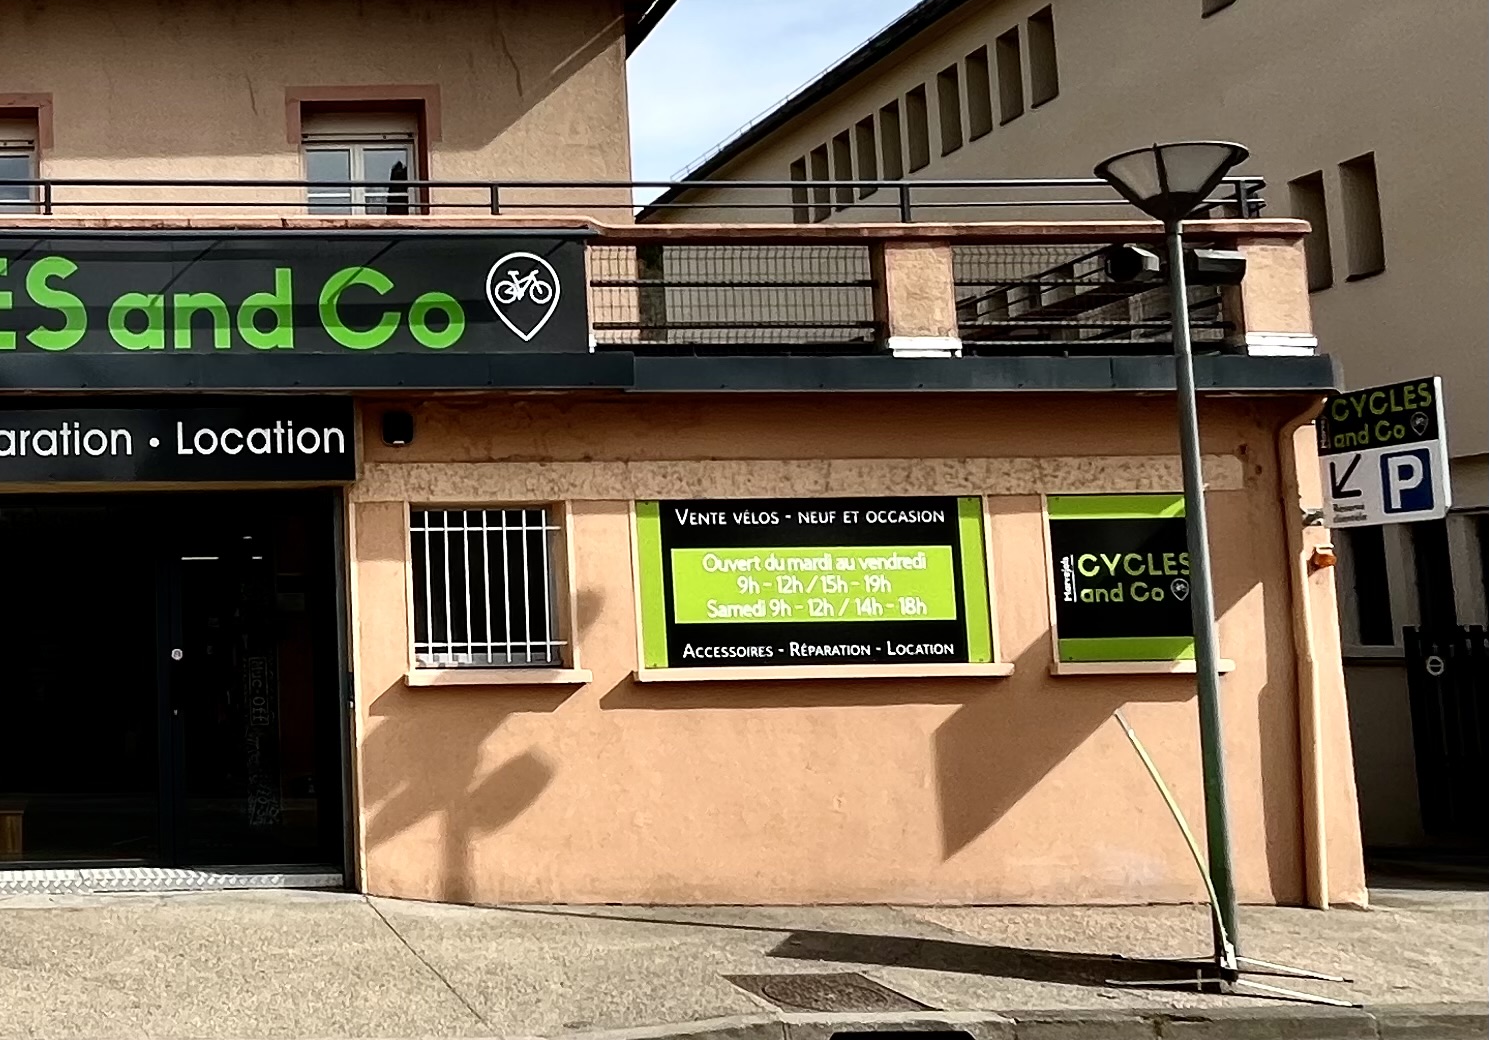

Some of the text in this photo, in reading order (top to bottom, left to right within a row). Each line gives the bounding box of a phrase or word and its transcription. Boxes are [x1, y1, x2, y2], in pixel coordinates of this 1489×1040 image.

[108, 267, 295, 351] and
[318, 266, 466, 350] Co
[1331, 383, 1432, 421] CYCLES
[177, 420, 345, 455] Location
[1334, 424, 1370, 448] and
[1375, 420, 1406, 442] Co
[1387, 454, 1424, 509] P
[674, 508, 727, 526] VENTE
[733, 509, 780, 525] VÉLOS
[797, 510, 836, 525] NEUF
[843, 510, 860, 524] ET
[865, 510, 945, 524] OCCASION
[702, 551, 927, 572] Ouvert du mardi au vendredi
[1077, 552, 1190, 577] CYCLES
[737, 575, 761, 594] 9h
[776, 574, 804, 594] 12h
[820, 574, 849, 594] 15h
[864, 574, 892, 593] 19h
[1079, 581, 1165, 603] and Co
[707, 599, 767, 618] Samedi
[768, 598, 792, 617] 9h
[808, 598, 835, 617] 12h
[854, 598, 884, 616] 14h
[898, 596, 928, 616] 18h
[682, 643, 774, 659] ACCESSOIRES
[789, 641, 871, 657] RÉPARATION
[886, 640, 955, 656] LOCATION
